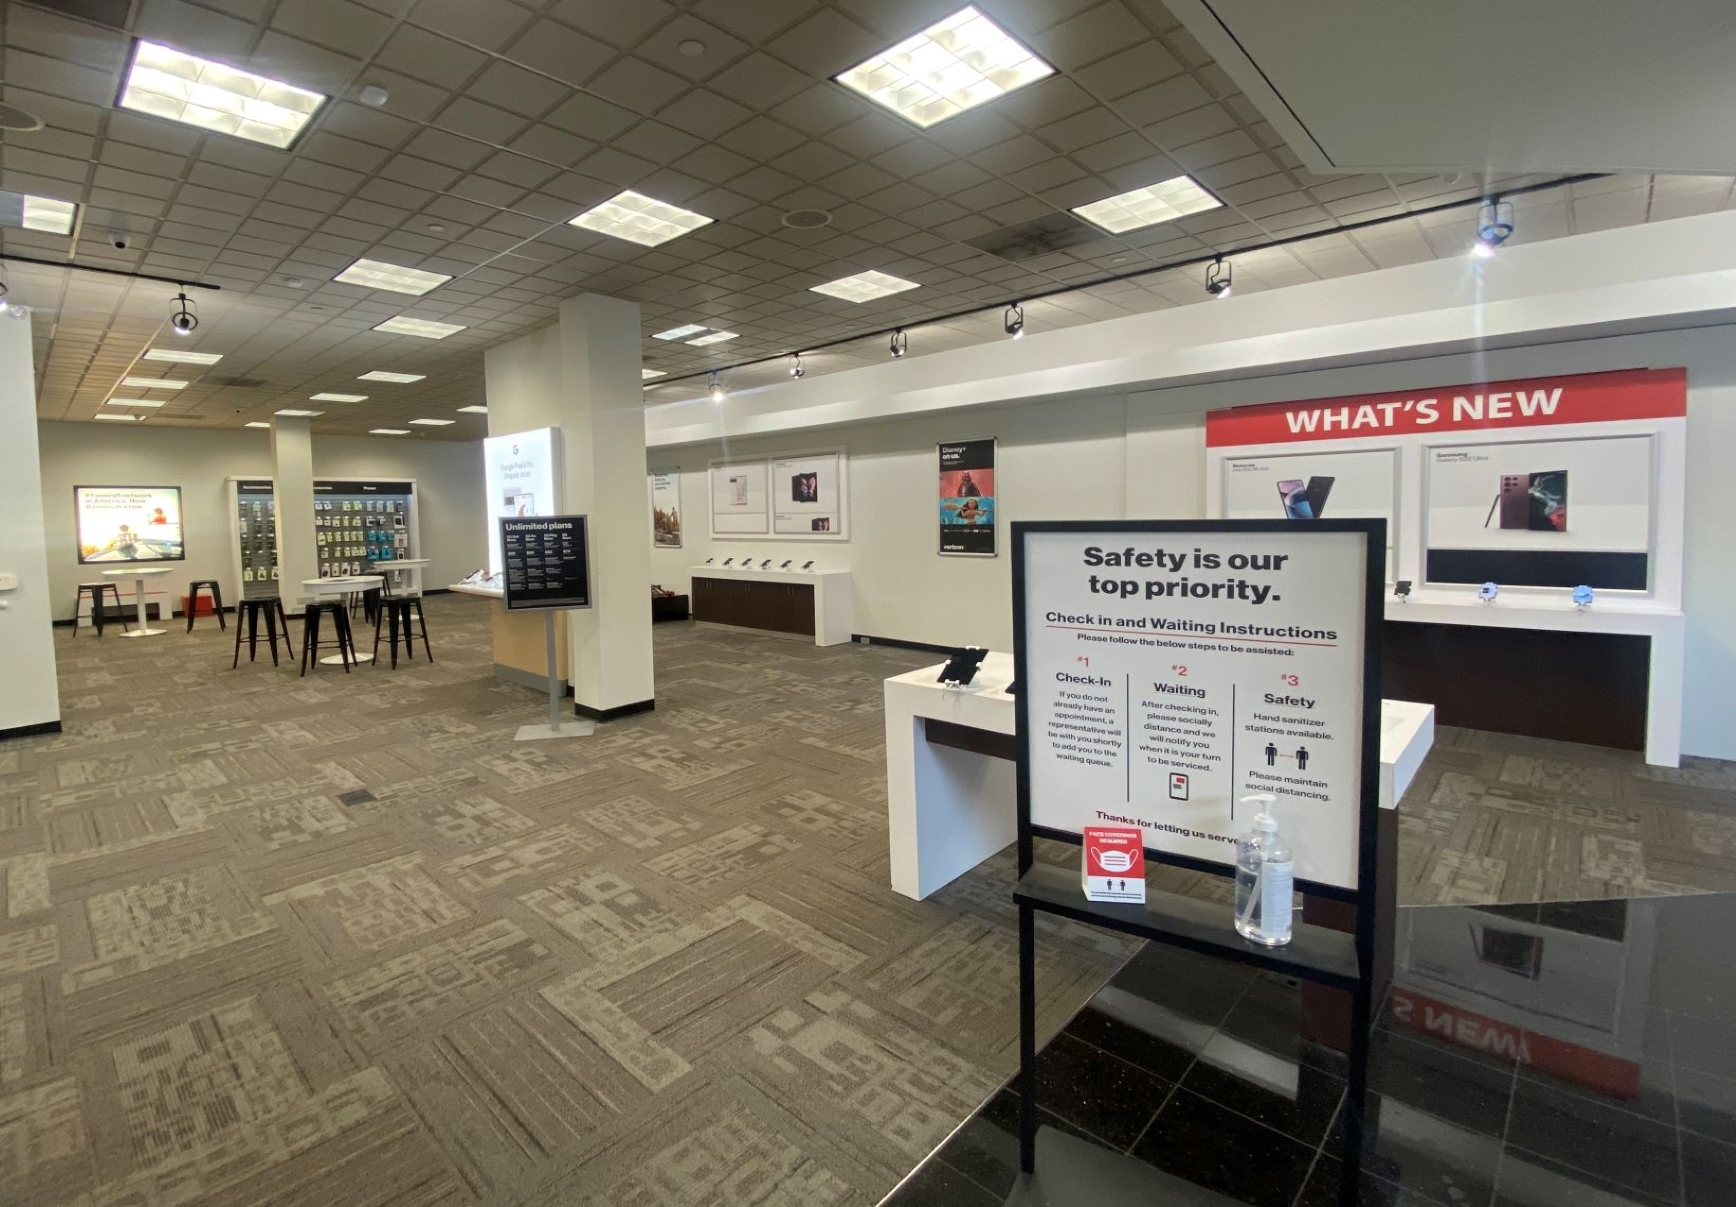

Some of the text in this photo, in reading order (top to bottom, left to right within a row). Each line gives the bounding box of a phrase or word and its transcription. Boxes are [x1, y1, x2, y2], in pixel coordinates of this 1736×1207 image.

[1285, 387, 1564, 433] WHAT'S NEW
[505, 522, 573, 530] Unlimited plans
[1083, 547, 1288, 573] Safety is our
[1089, 574, 1281, 605] top priority.
[1046, 611, 1338, 640] Check in and Waiting Instructions
[1077, 633, 1295, 656] Please follow the below steps to be assisted:
[1077, 656, 1089, 667] #1
[1172, 664, 1188, 676] #2
[1056, 672, 1112, 687] Check-In
[1281, 674, 1300, 686] #3
[1066, 692, 1081, 700] you
[1153, 682, 1206, 698] Waiting
[1053, 700, 1082, 710] already
[1084, 704, 1104, 712] have
[1142, 700, 1220, 717] After checking in,
[1264, 693, 1316, 709] Safety
[1054, 712, 1108, 725] appointment,
[1146, 712, 1213, 728] please socially
[1254, 712, 1326, 728] Hand sanitizer
[1048, 721, 1106, 735] representative
[1144, 723, 1182, 734] distance
[1182, 728, 1200, 736] and
[1245, 724, 1334, 741] stations available.
[1048, 730, 1122, 749] be with you shortly
[1149, 735, 1210, 750] will notify you
[1061, 743, 1076, 751] add
[1077, 746, 1092, 754] you
[1104, 750, 1118, 758] the
[1139, 744, 1162, 754] when
[1171, 748, 1179, 756] is
[1180, 750, 1200, 760] your
[1202, 753, 1222, 762] turn
[1056, 752, 1114, 768] waiting queue.
[1148, 756, 1212, 772] to be serviced.
[1249, 770, 1328, 788] Please maintain
[1245, 783, 1331, 802] social distancing.
[1096, 810, 1136, 826] Thanks
[1137, 818, 1152, 829] for
[1154, 822, 1190, 839] letting
[1191, 830, 1205, 840] us
